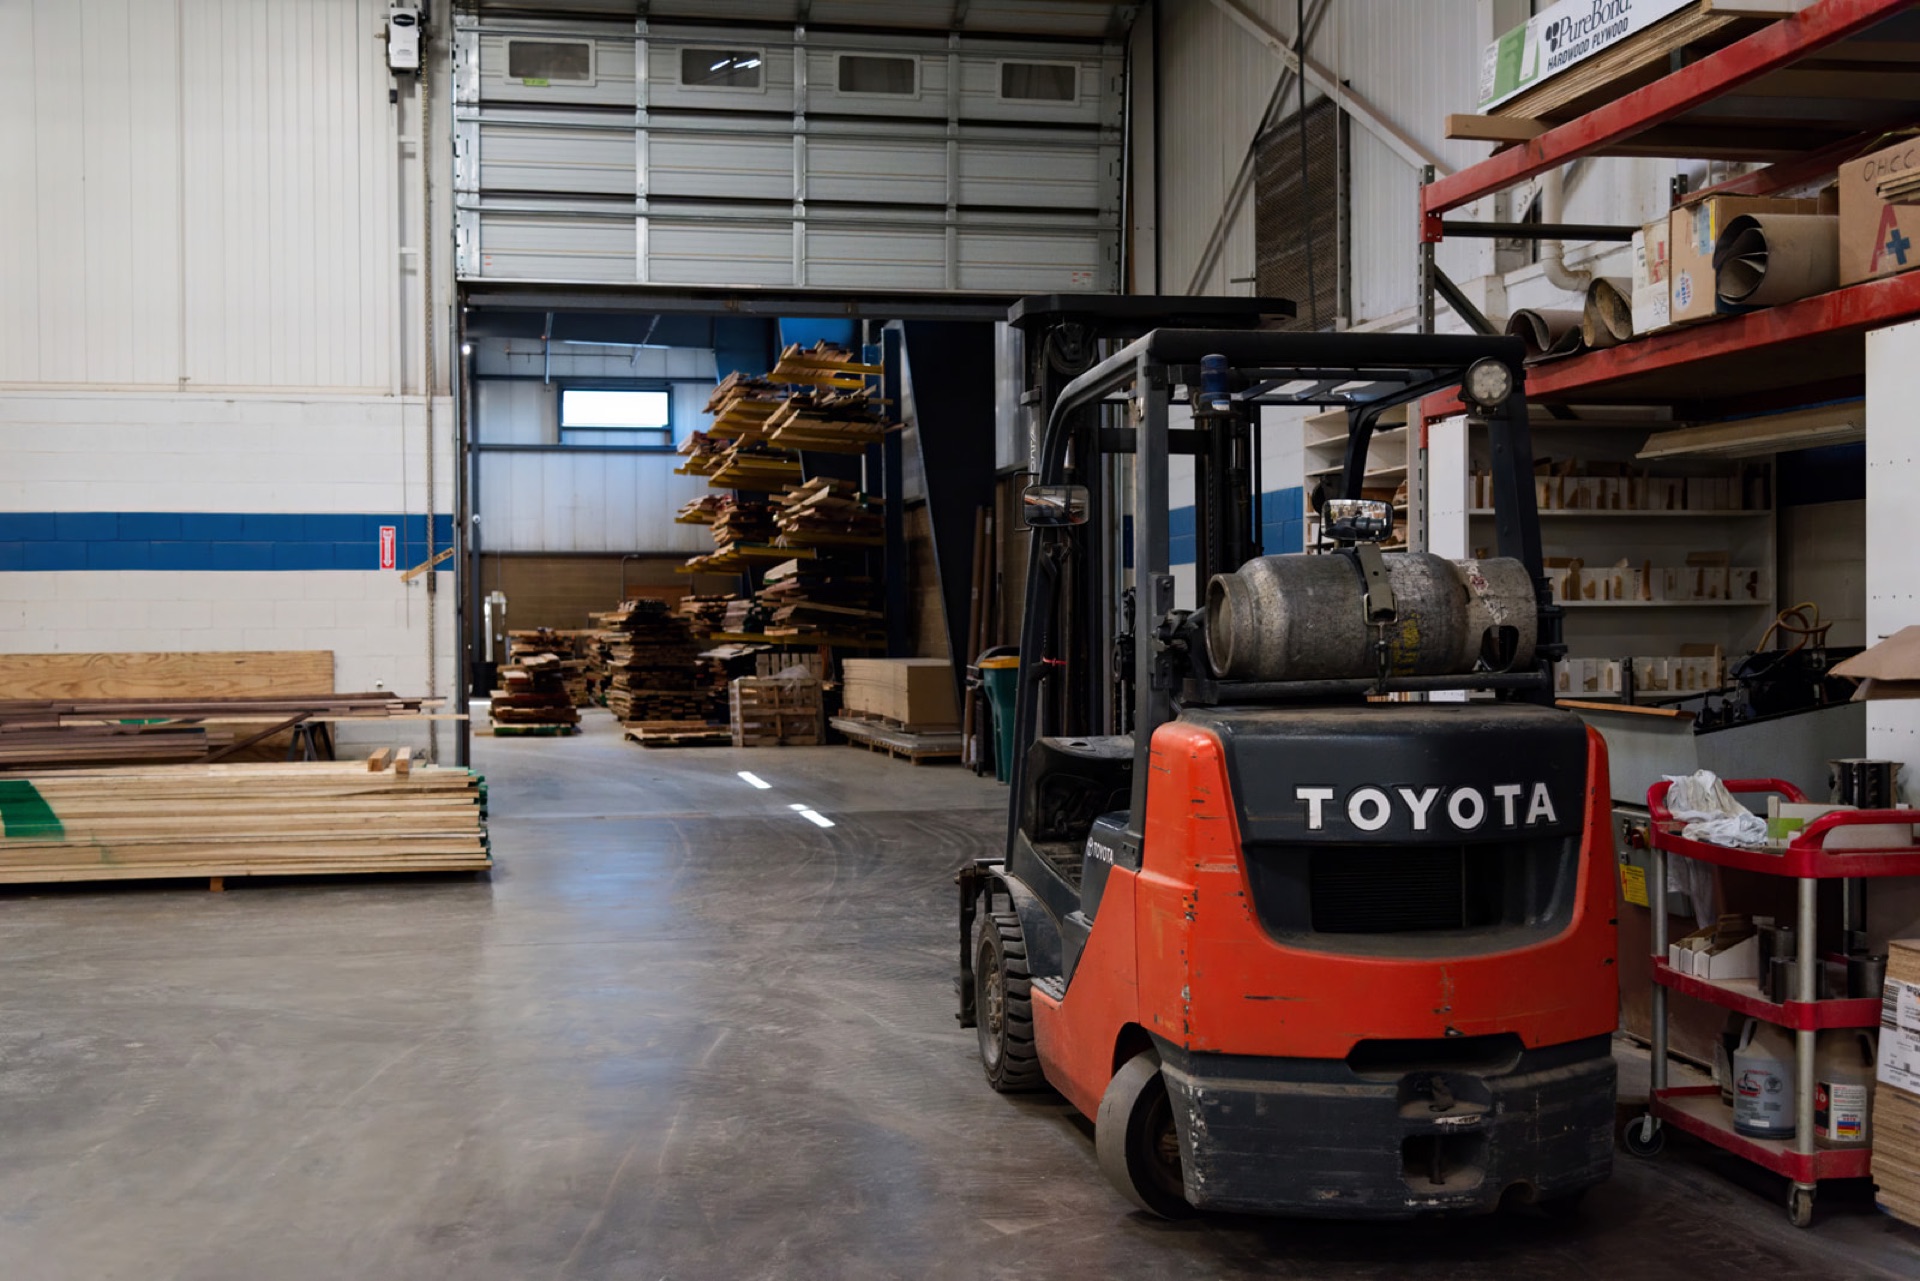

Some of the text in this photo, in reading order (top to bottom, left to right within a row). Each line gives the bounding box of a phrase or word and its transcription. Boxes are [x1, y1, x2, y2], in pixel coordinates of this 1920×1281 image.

[1549, 18, 1628, 69] HARDWOOD PLYWOOD
[1296, 783, 1557, 830] TOYOTA
